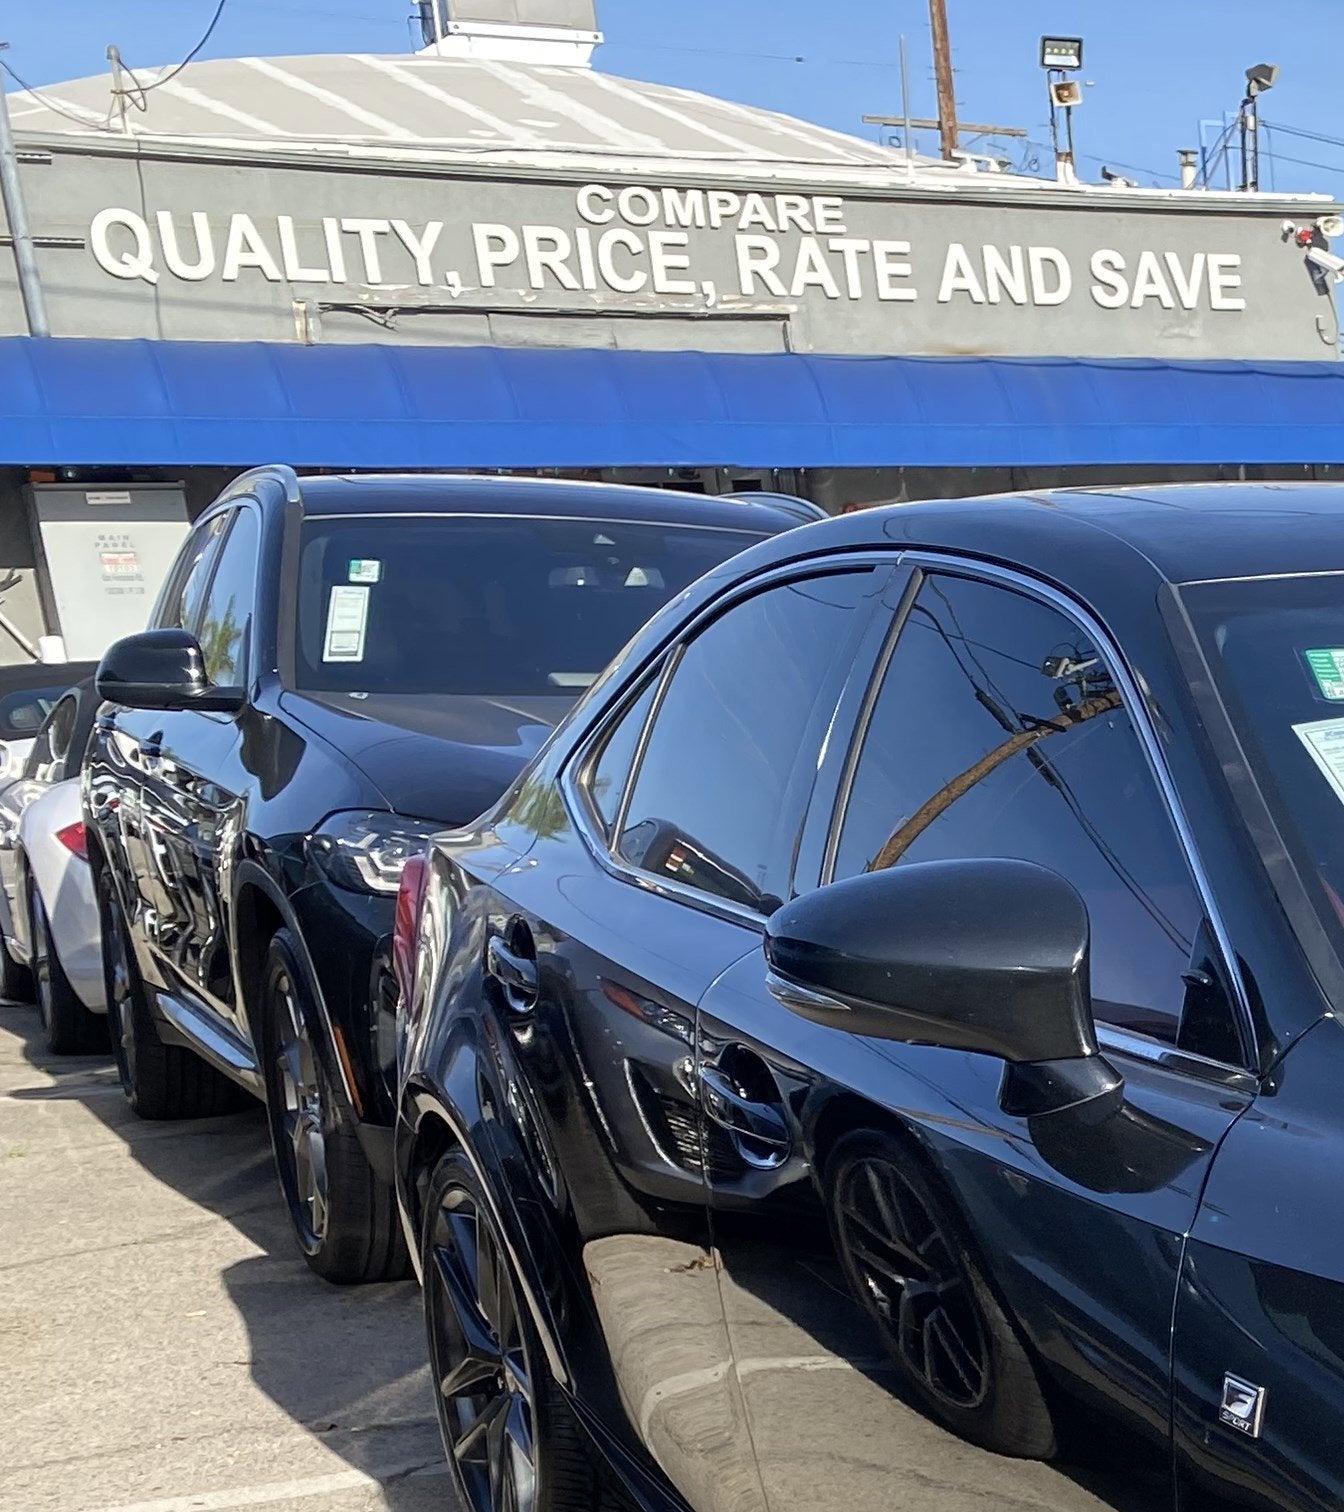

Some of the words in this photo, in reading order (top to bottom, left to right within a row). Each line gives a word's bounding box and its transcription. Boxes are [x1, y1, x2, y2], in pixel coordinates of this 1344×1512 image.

[576, 183, 847, 233] COMPARE
[89, 207, 464, 299] QUALITY,
[471, 222, 716, 307] PRICE,
[733, 233, 918, 301] RATE
[937, 242, 1073, 306] AND
[1090, 247, 1246, 311] SAVE
[1222, 1410, 1252, 1431] SPORT
